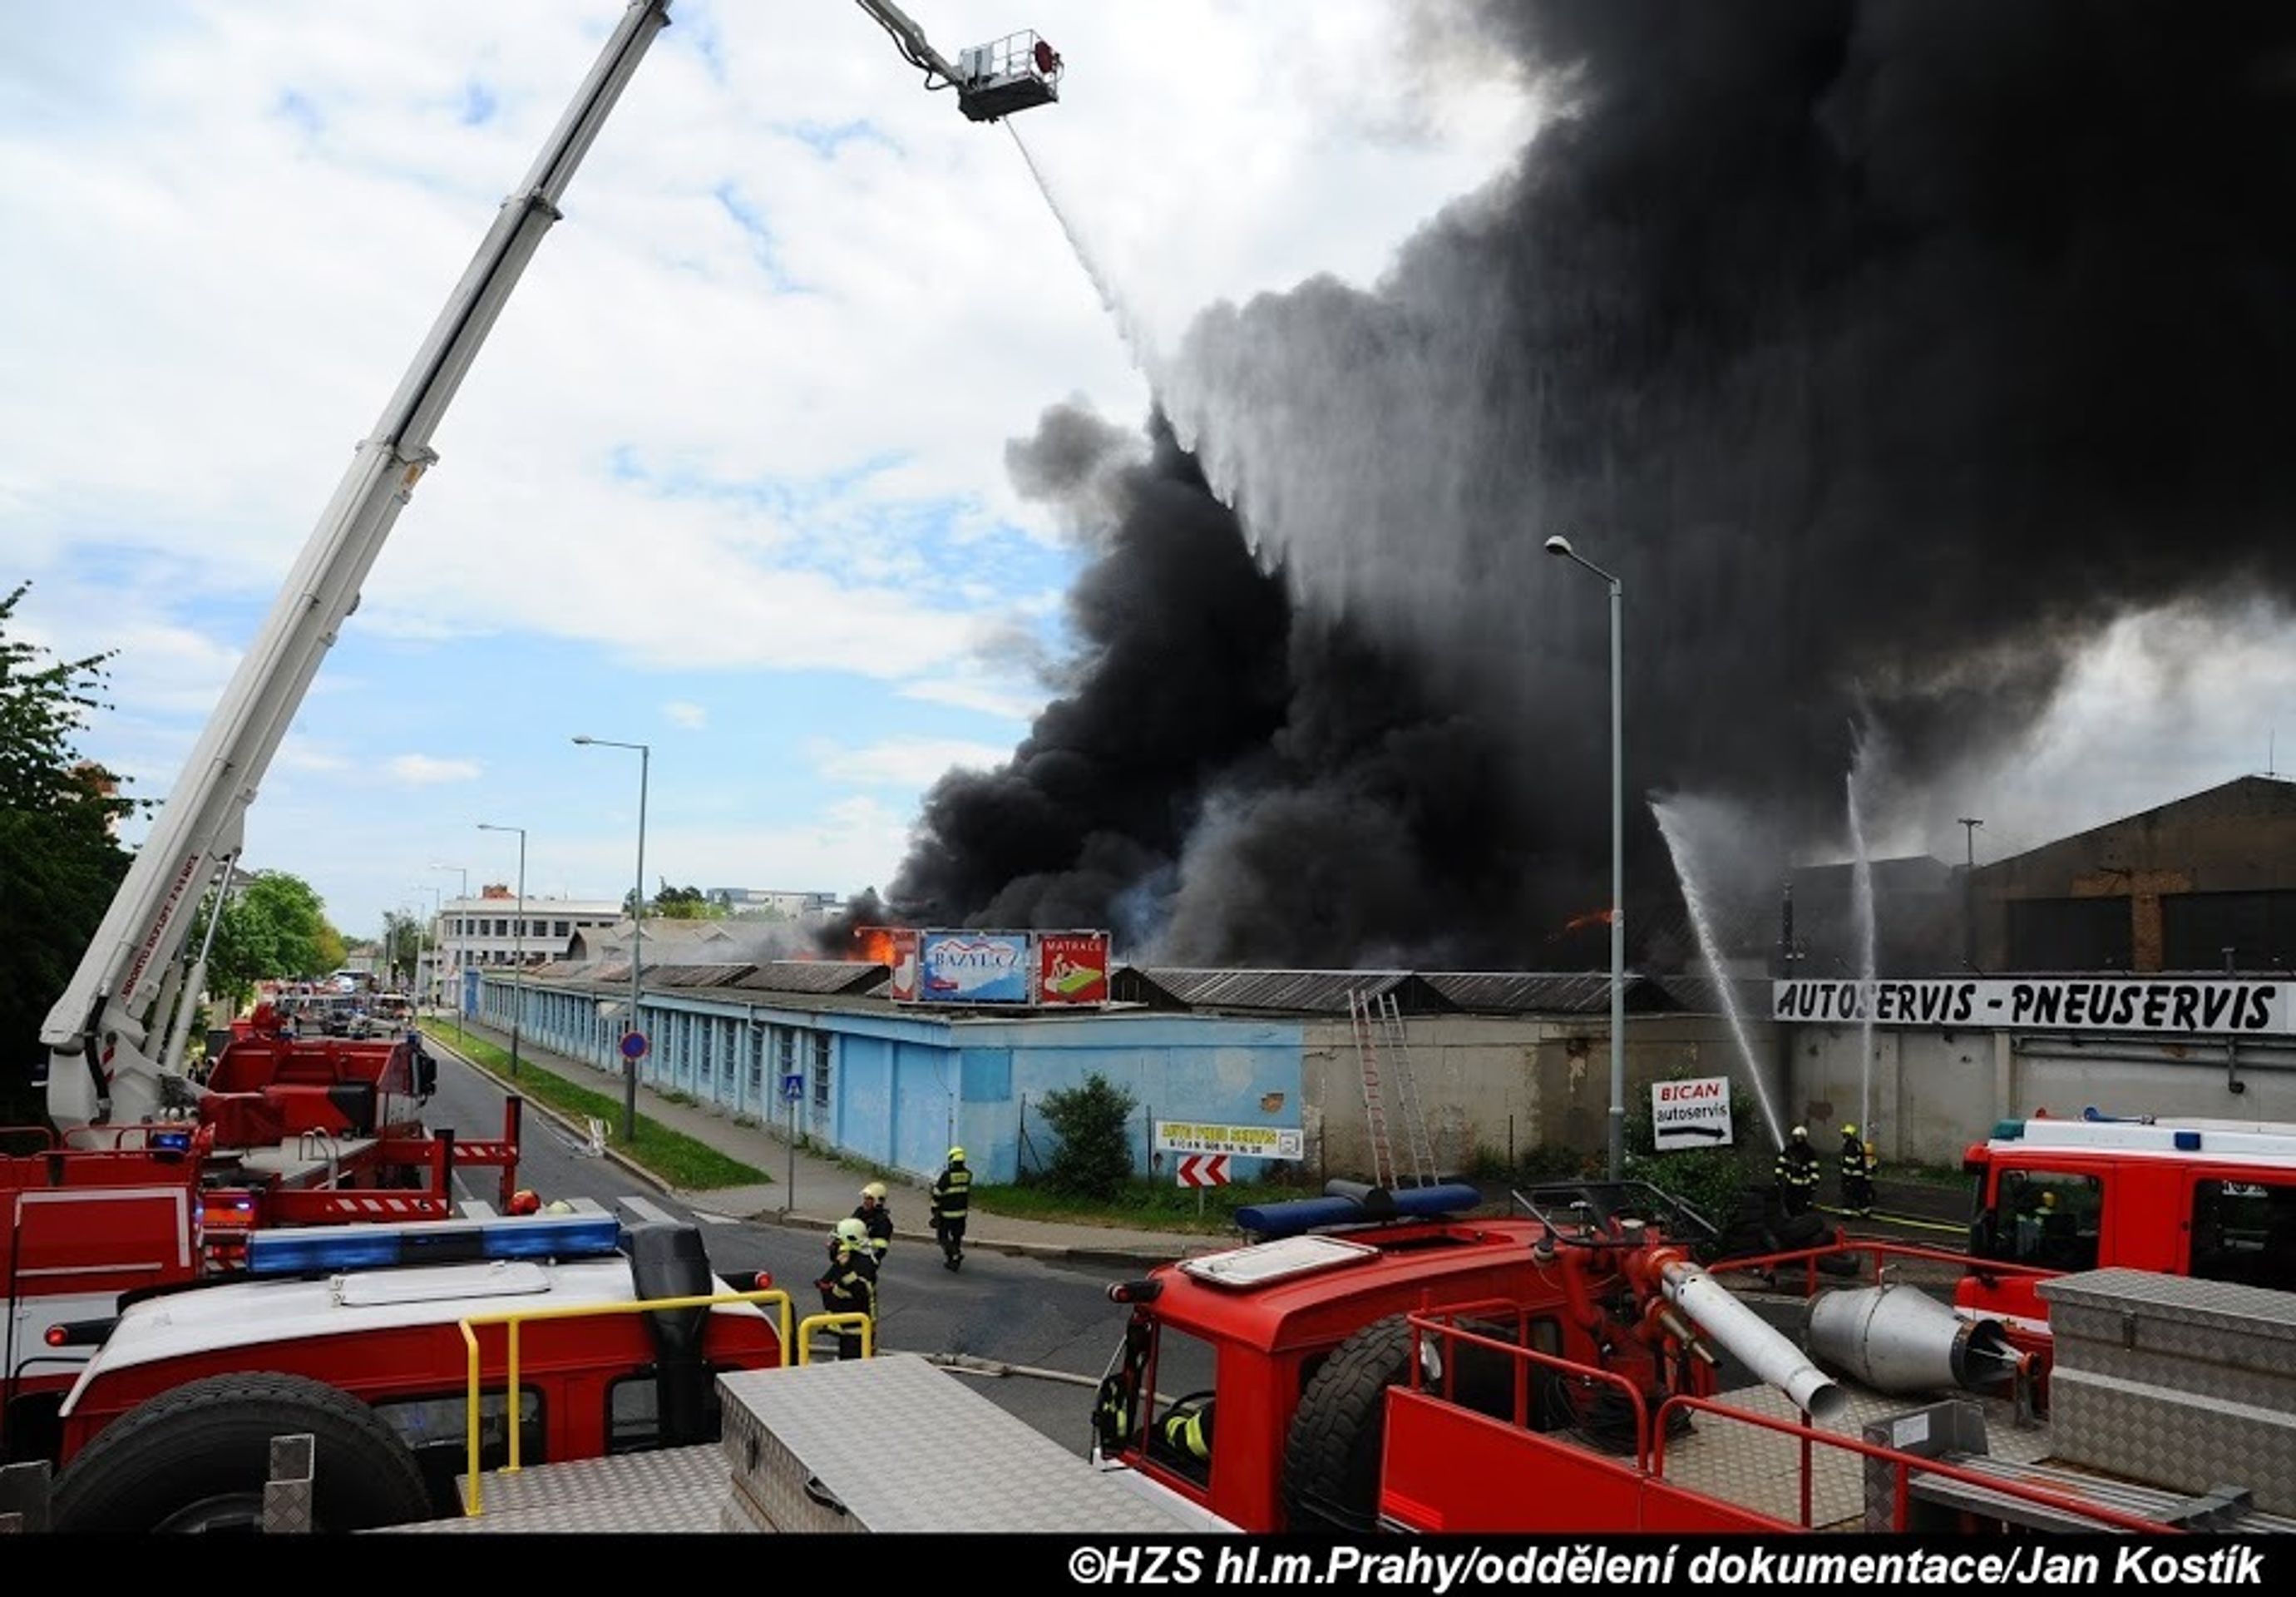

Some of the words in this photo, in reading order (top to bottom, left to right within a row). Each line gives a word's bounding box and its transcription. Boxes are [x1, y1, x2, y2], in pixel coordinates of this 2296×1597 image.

[1045, 940, 1102, 952] MATRACE
[1776, 983, 1977, 1021] AUTOSERVIS
[2011, 984, 2276, 1031] PNEUSERVIS
[1662, 1083, 1720, 1101] BICAN
[1657, 1102, 1728, 1122] autoservis
